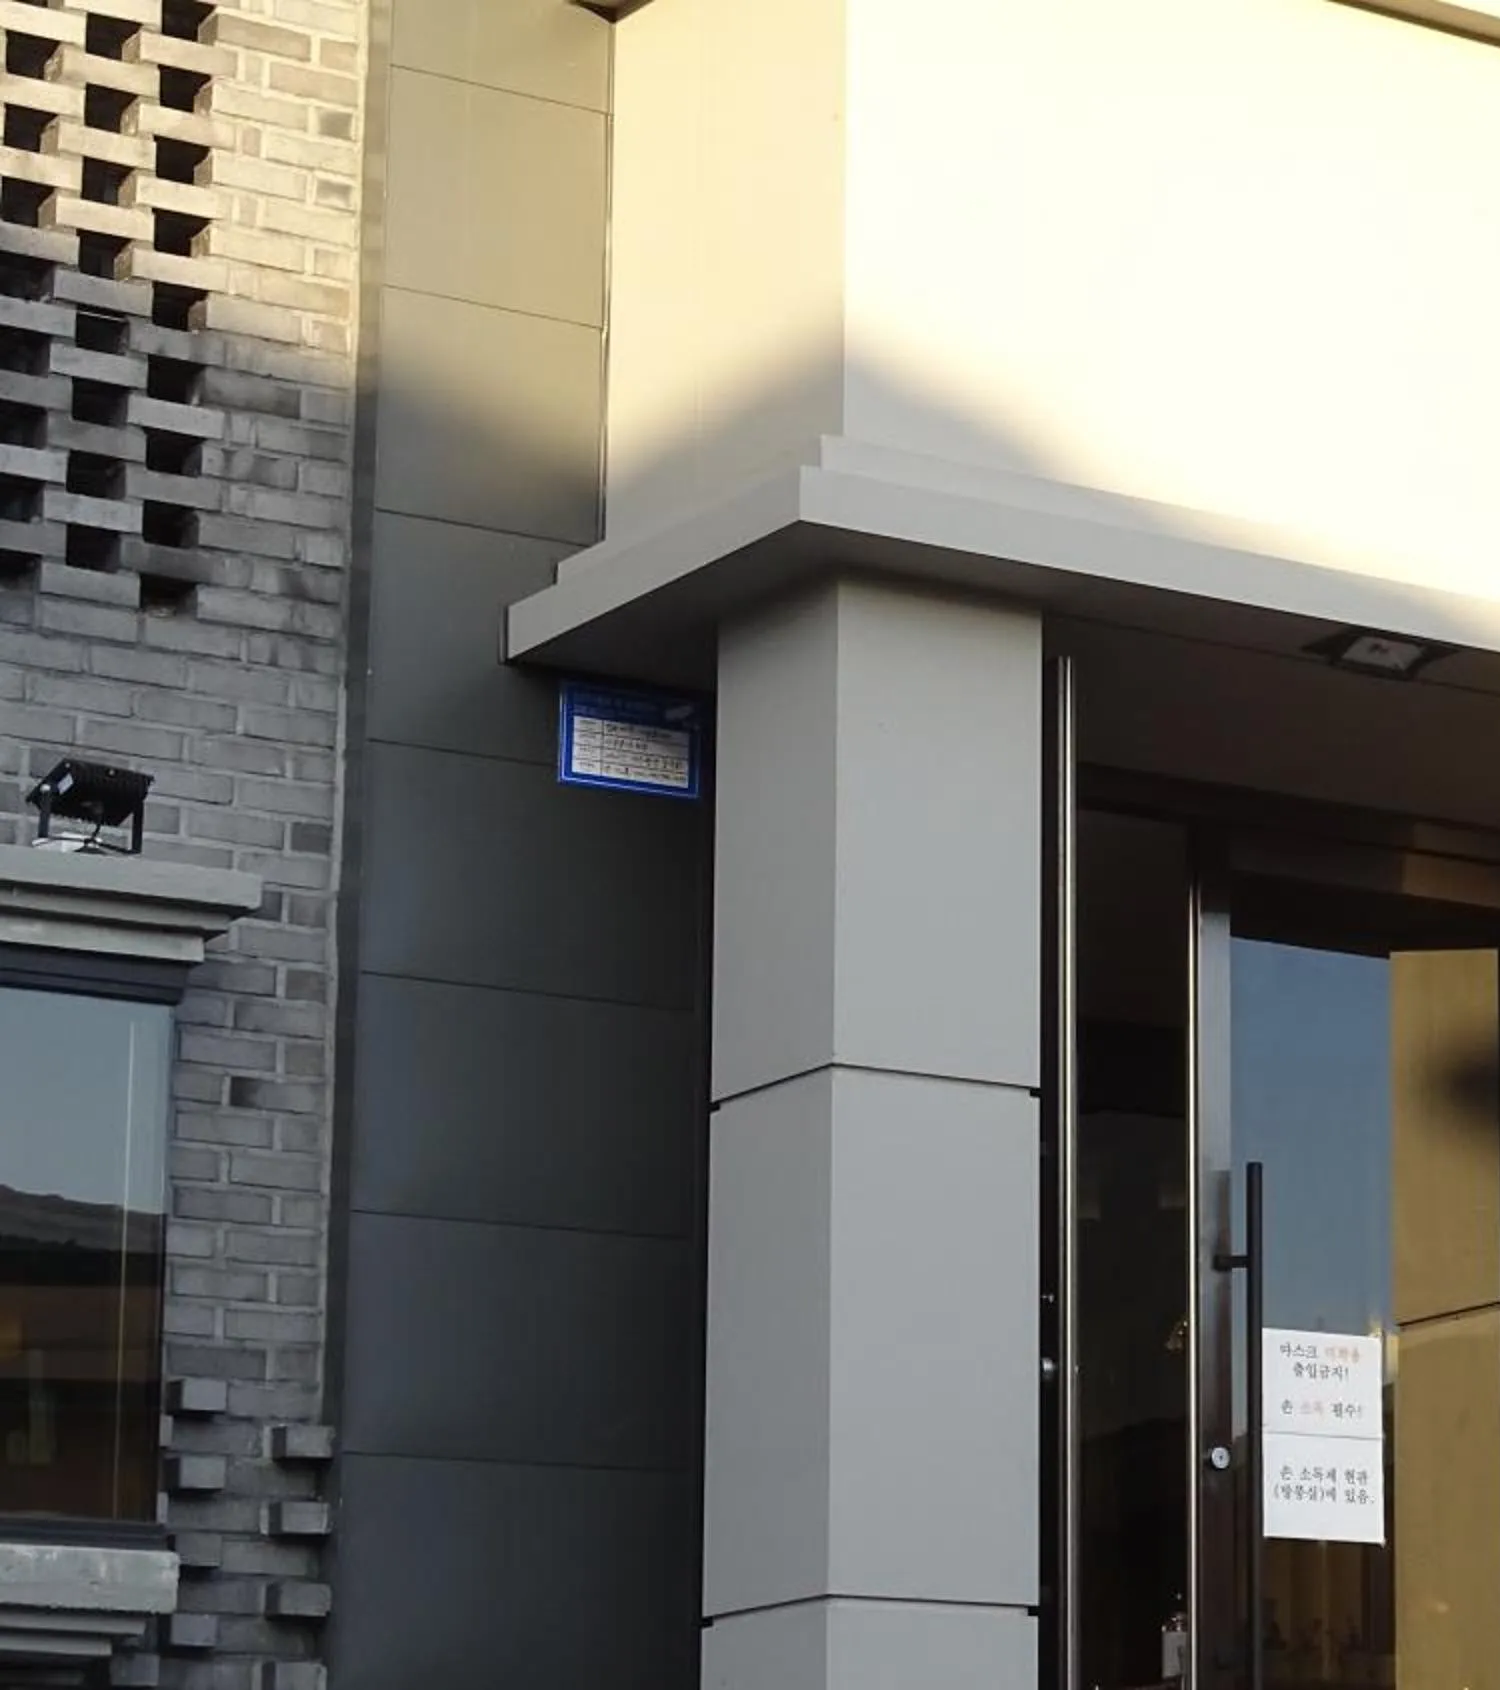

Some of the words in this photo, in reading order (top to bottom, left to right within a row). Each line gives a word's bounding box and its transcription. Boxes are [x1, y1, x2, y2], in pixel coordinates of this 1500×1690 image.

[1280, 1342, 1318, 1359] 마스크
[1293, 1361, 1349, 1381] 출입금지!
[1281, 1399, 1293, 1415] 손
[1280, 1465, 1293, 1481] 손
[1300, 1466, 1337, 1483] 소독제
[1344, 1468, 1368, 1485] 현관
